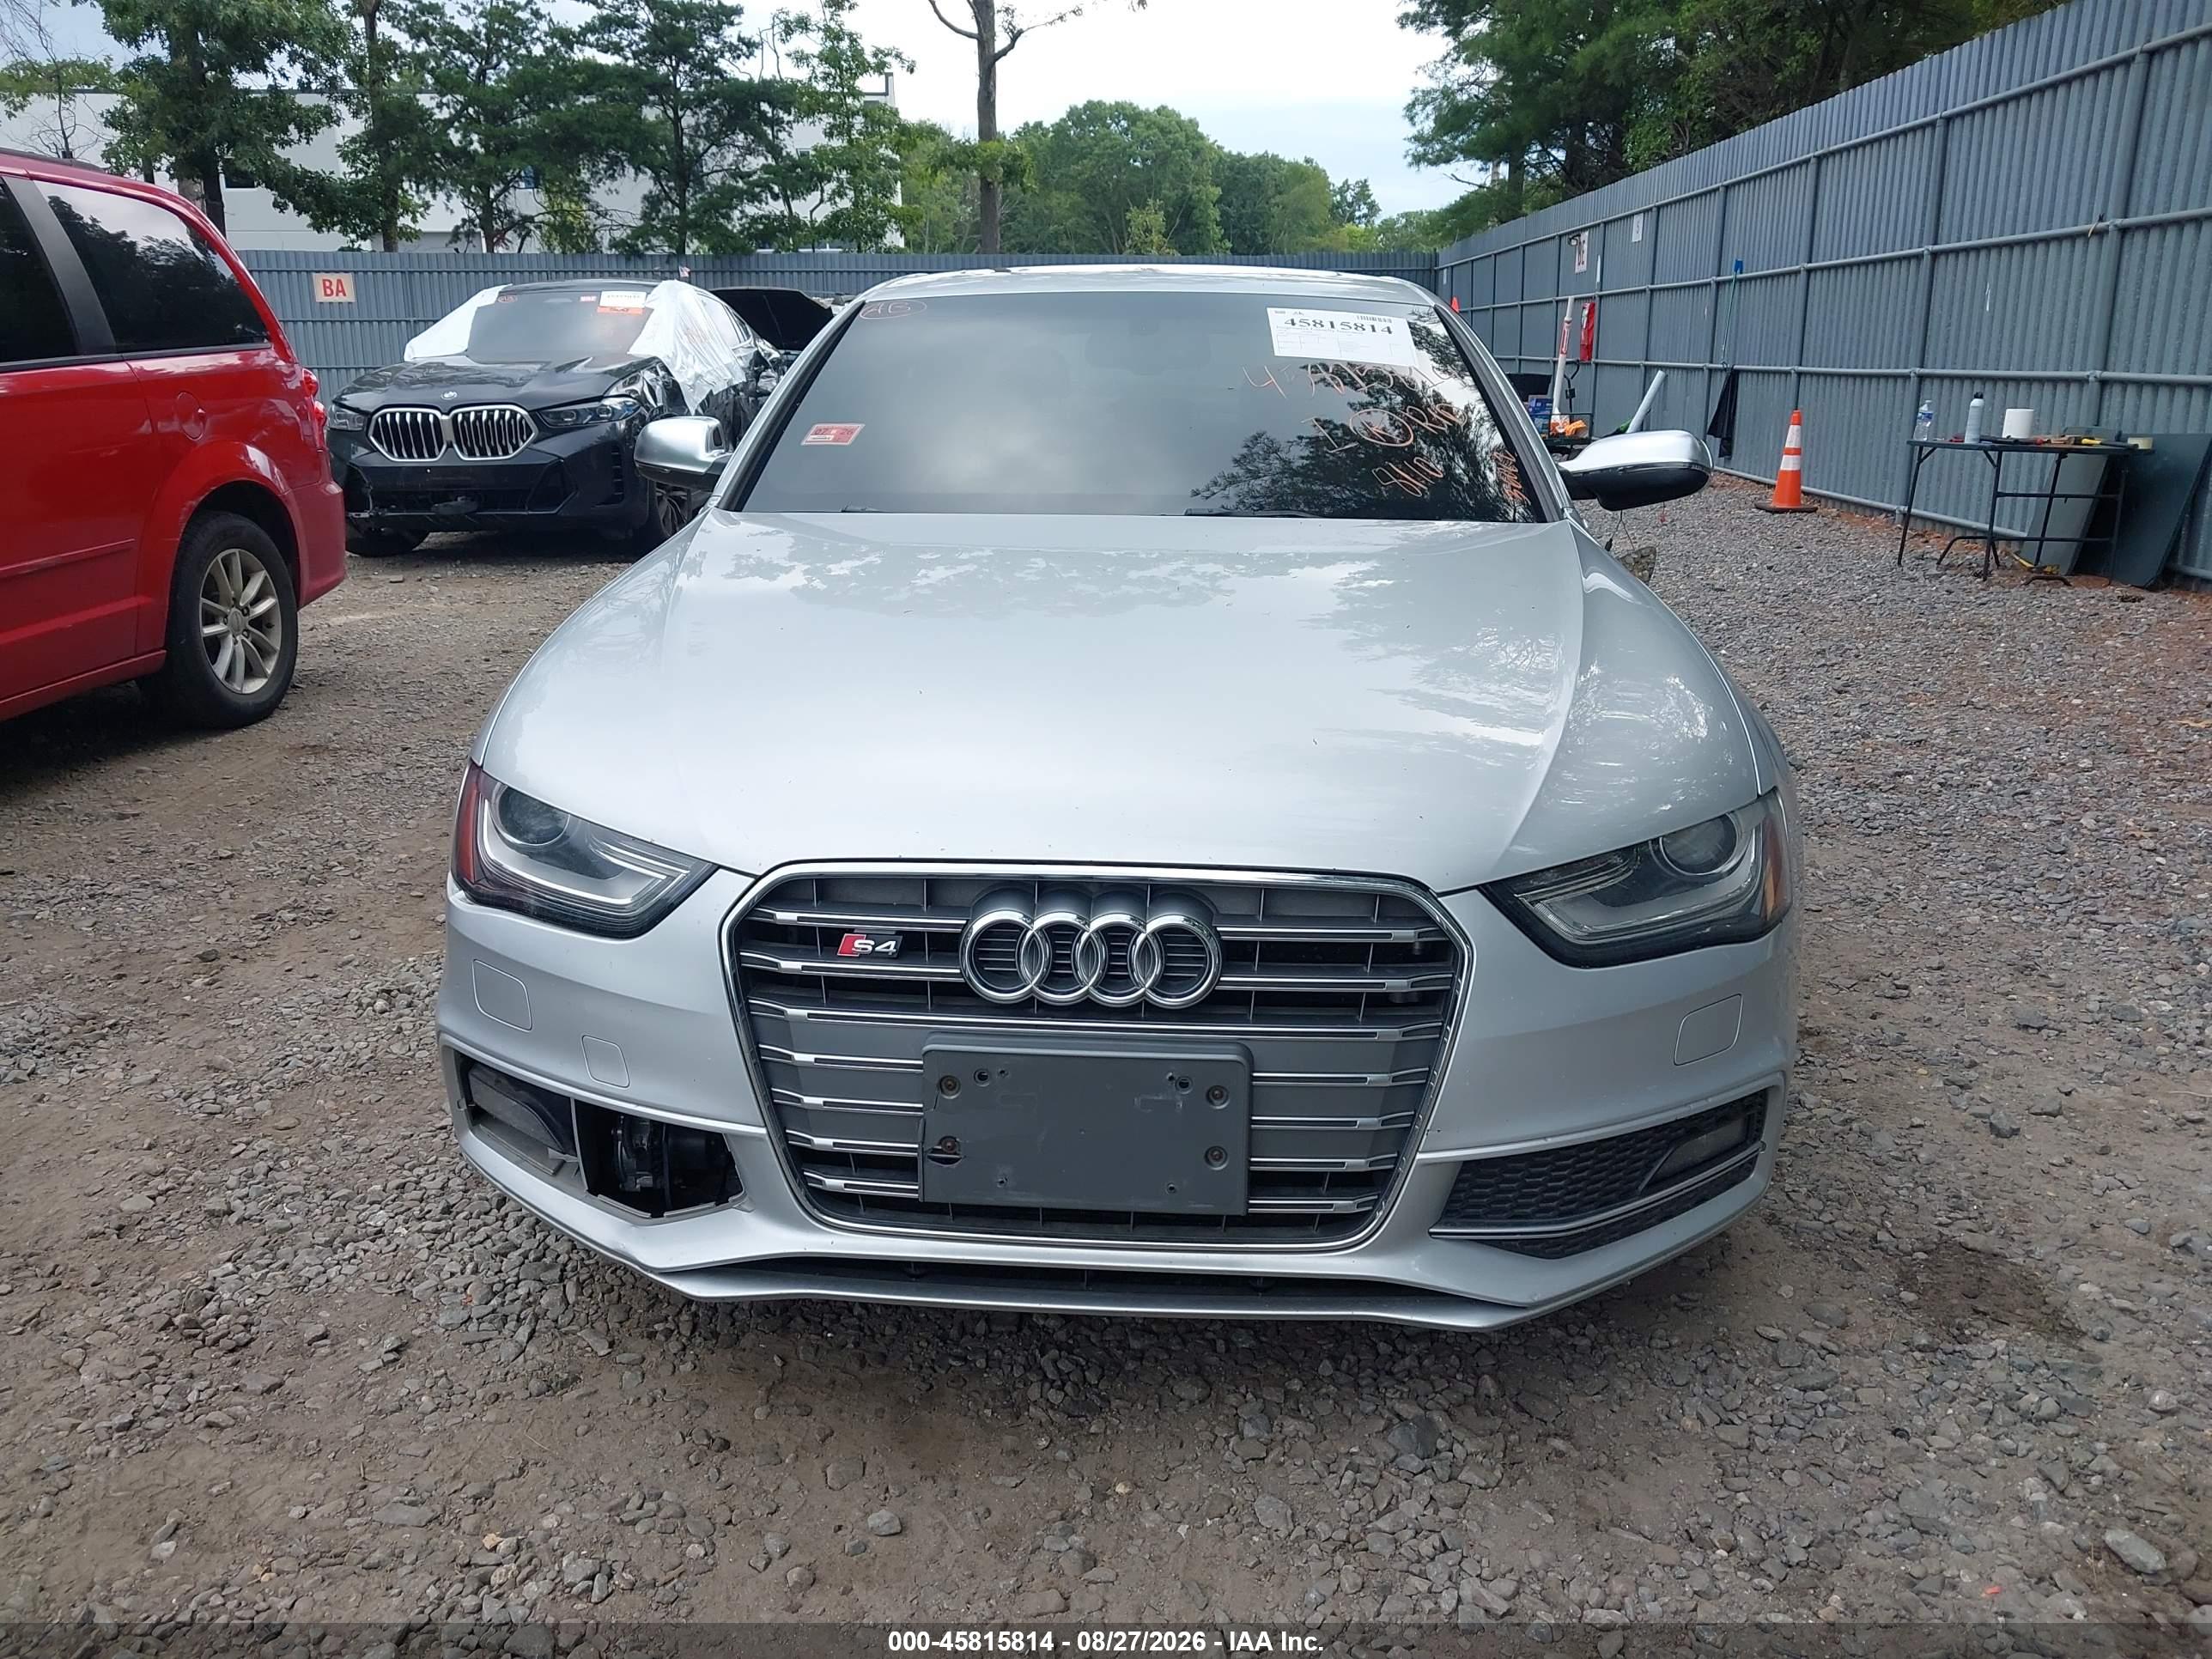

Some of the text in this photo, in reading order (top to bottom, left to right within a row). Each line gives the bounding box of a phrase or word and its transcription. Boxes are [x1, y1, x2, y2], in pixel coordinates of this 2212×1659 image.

[322, 278, 347, 297] BA
[1284, 318, 1394, 335] 45815814
[852, 939, 897, 956] S4
